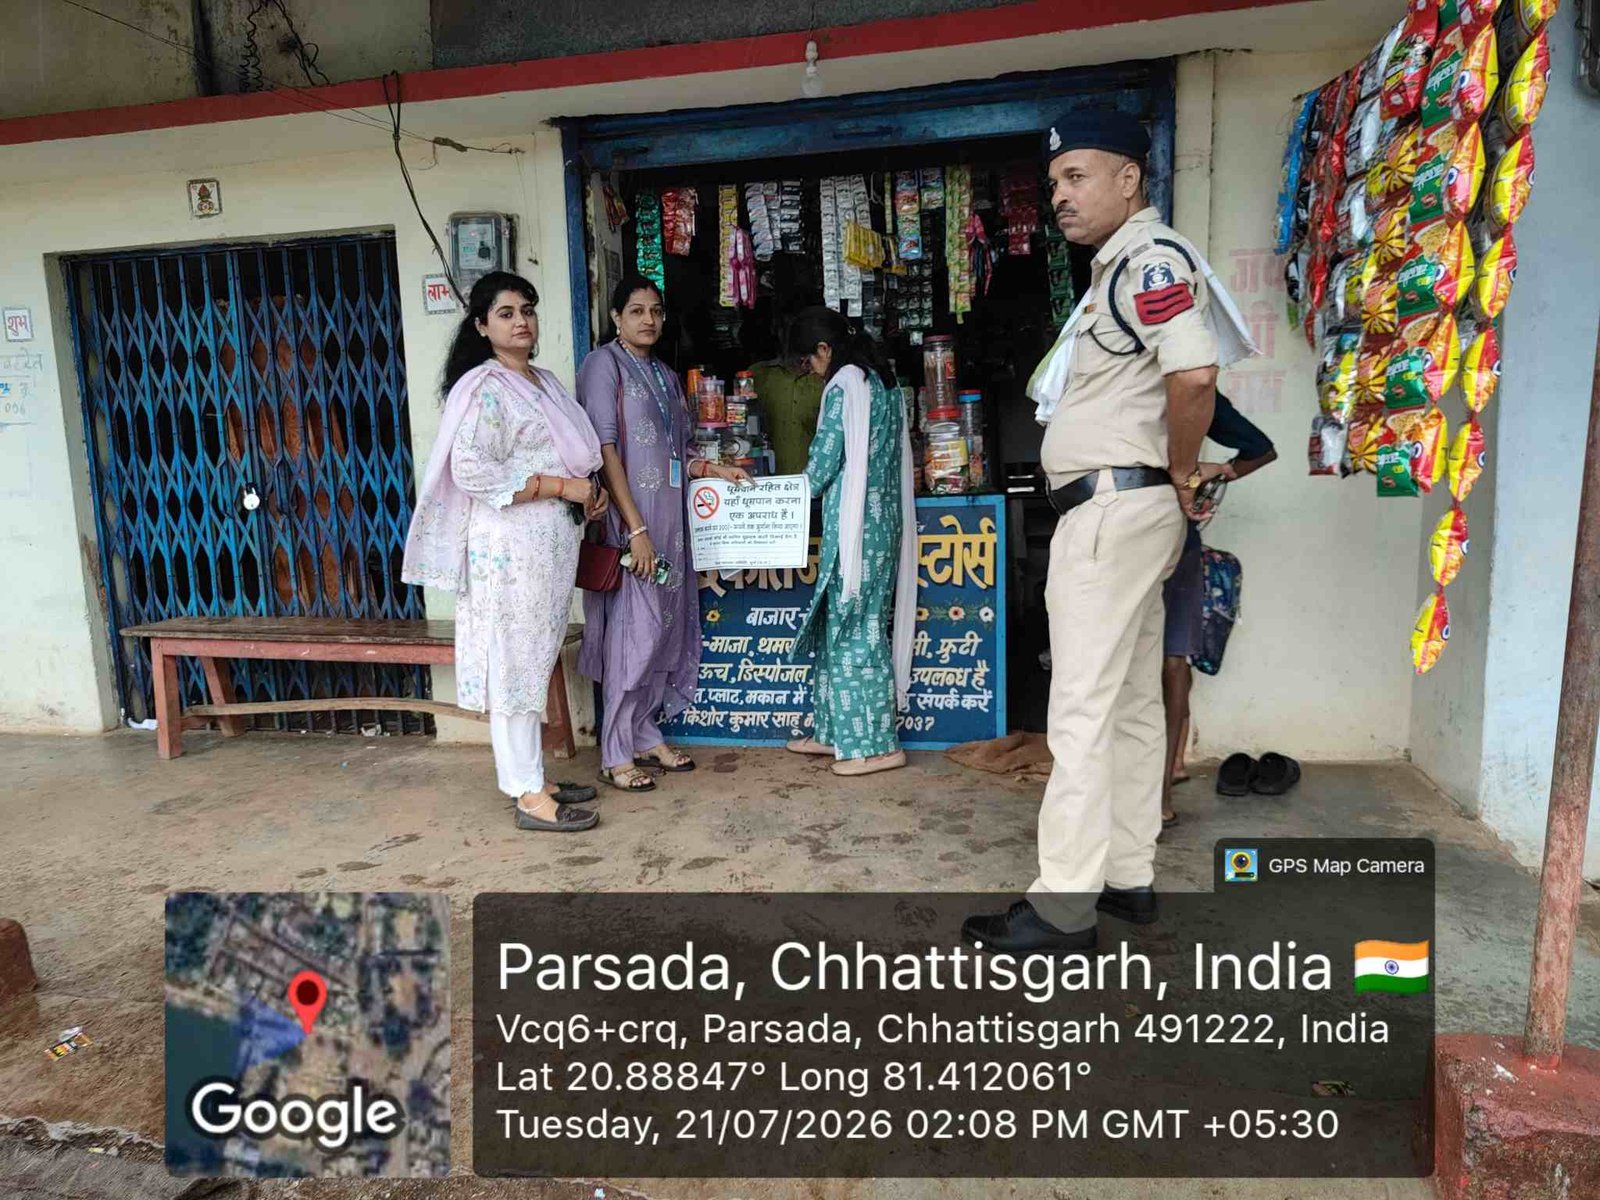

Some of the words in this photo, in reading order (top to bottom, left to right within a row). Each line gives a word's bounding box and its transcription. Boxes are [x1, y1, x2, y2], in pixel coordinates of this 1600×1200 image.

[759, 482, 781, 493] रहित
[783, 481, 800, 492] क्षेत्र
[724, 495, 740, 507] यहाँ
[774, 497, 801, 506] करना
[729, 511, 744, 521] एक
[747, 511, 778, 520] अपराध
[746, 607, 801, 630] बाजार
[909, 667, 972, 688] उपलब्ध
[971, 659, 991, 691] है
[745, 690, 790, 705] मकान
[792, 684, 808, 705] में
[917, 688, 960, 710] संपर्क
[961, 688, 993, 713] करें
[683, 706, 728, 727] किशोर
[729, 711, 770, 732] कुमार
[772, 711, 803, 735] साहू
[896, 715, 935, 732] 7037
